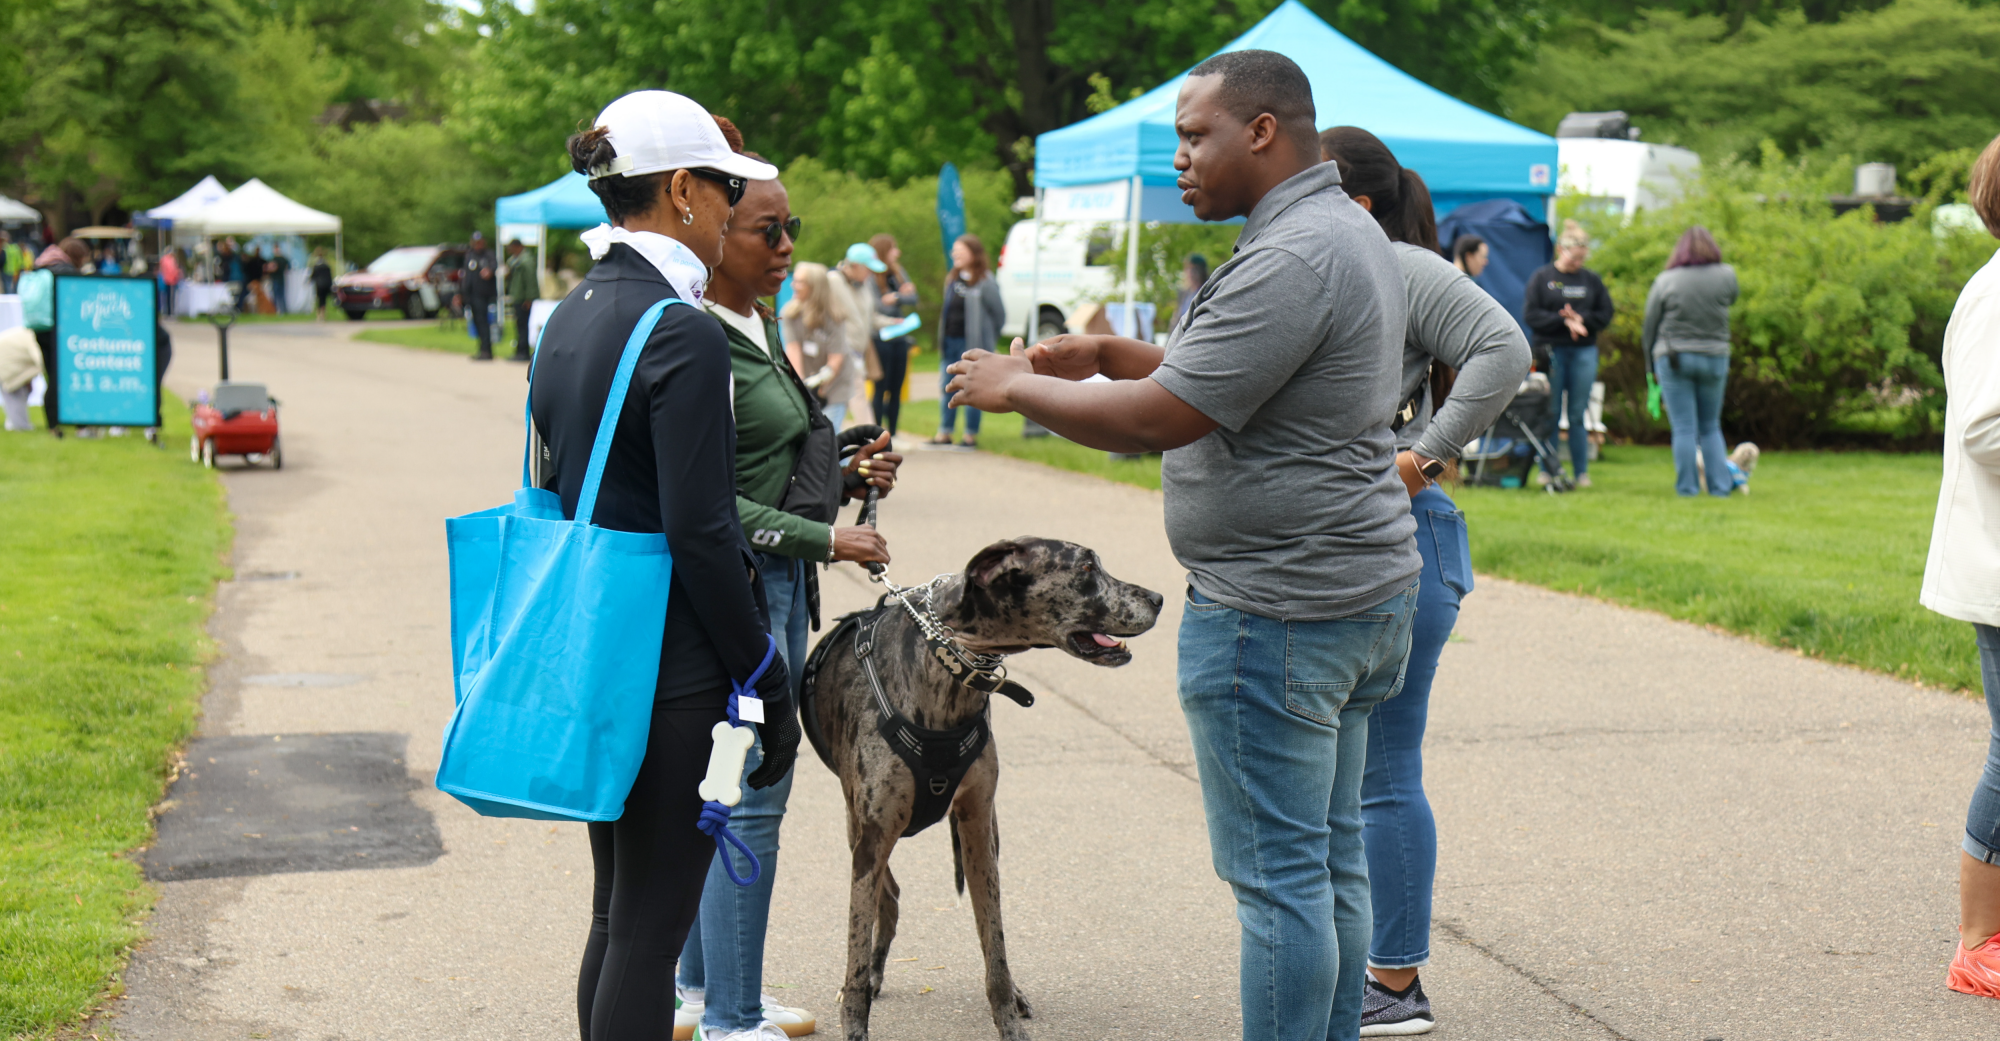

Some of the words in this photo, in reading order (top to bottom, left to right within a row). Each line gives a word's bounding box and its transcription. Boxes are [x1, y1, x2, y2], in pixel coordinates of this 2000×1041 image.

[680, 259, 705, 274] partner
[67, 335, 145, 354] Costume
[74, 353, 143, 371] Contest
[70, 372, 94, 391] 11
[100, 375, 147, 392] a.m.
